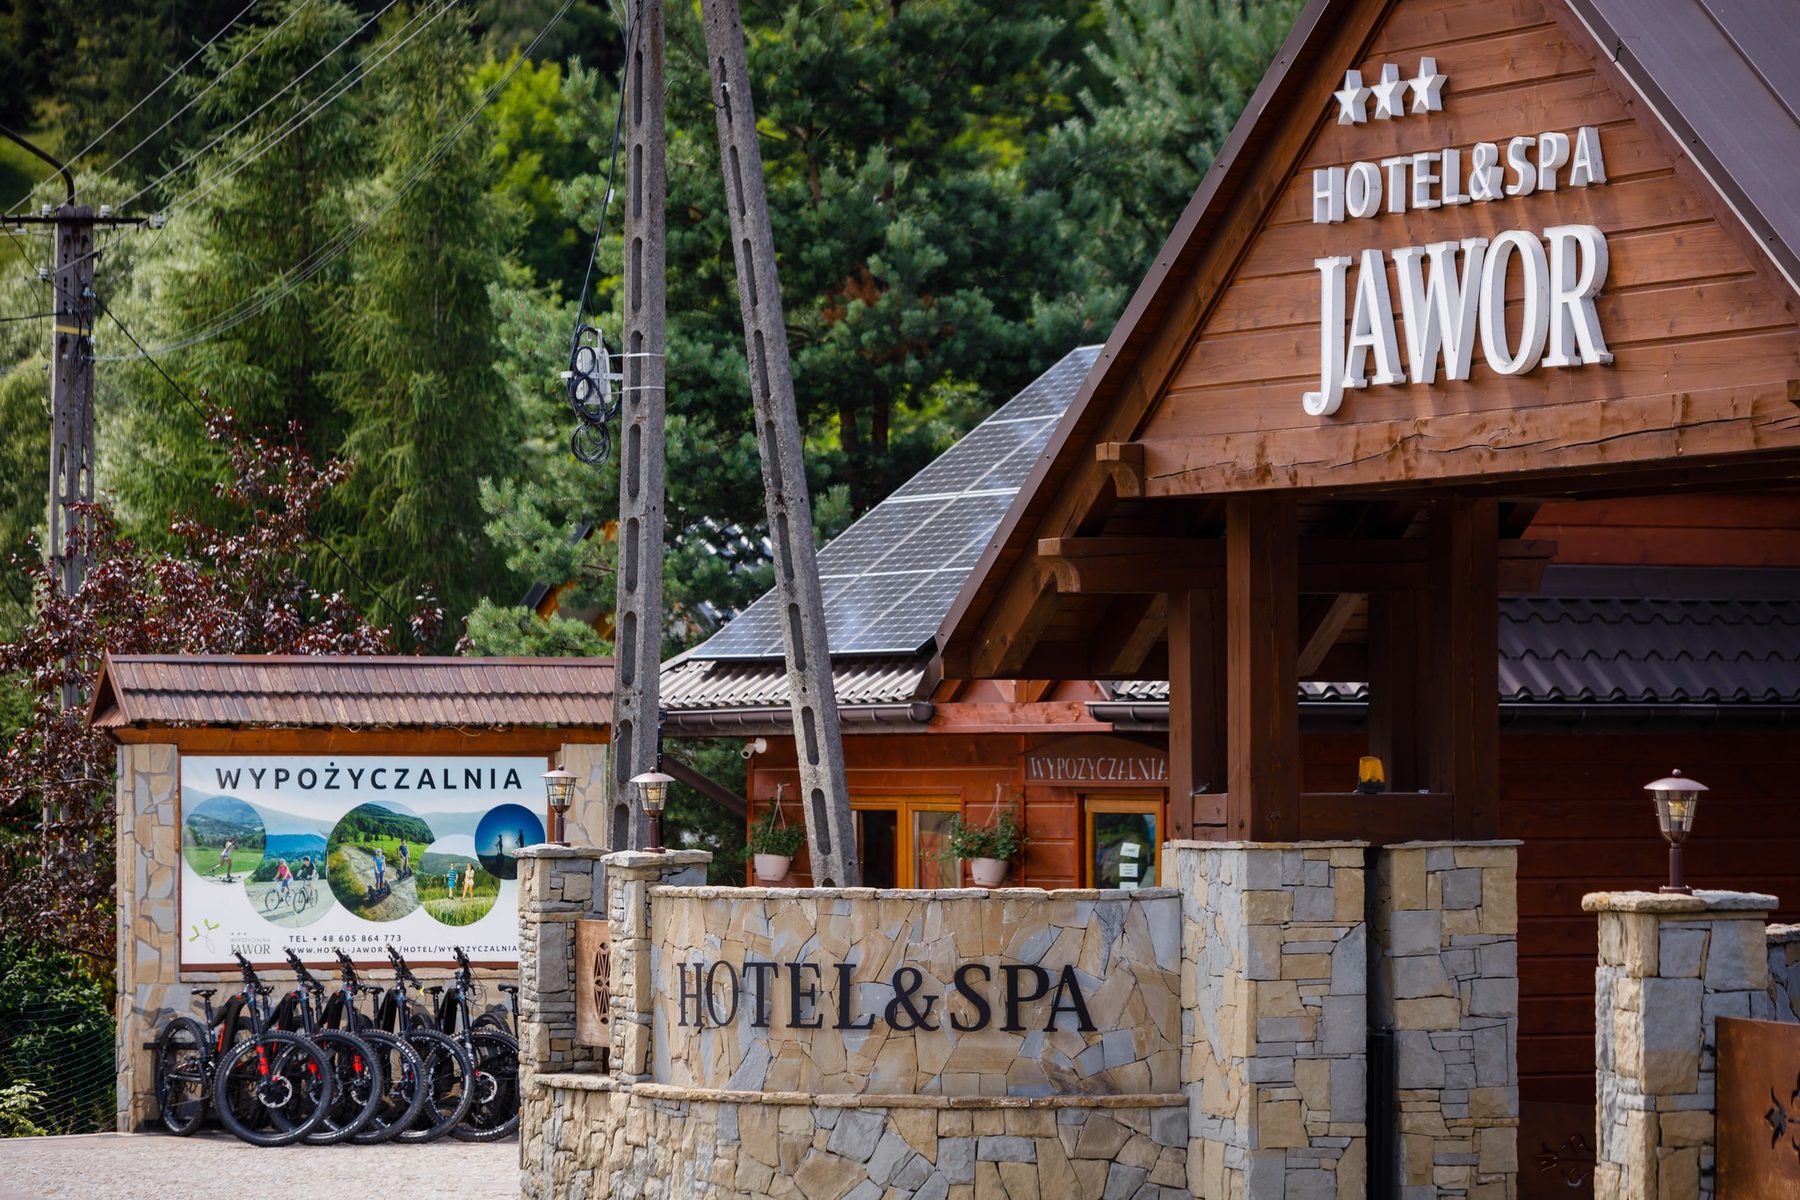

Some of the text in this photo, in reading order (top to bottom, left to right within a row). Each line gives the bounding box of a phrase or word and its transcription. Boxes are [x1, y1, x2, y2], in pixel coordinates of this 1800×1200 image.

[1303, 224, 1614, 416] JAWOR
[215, 762, 523, 790] WYPOŻYCZALNIA
[289, 935, 307, 943] TEL
[384, 934, 402, 942] 773
[229, 943, 271, 956] JAWOR
